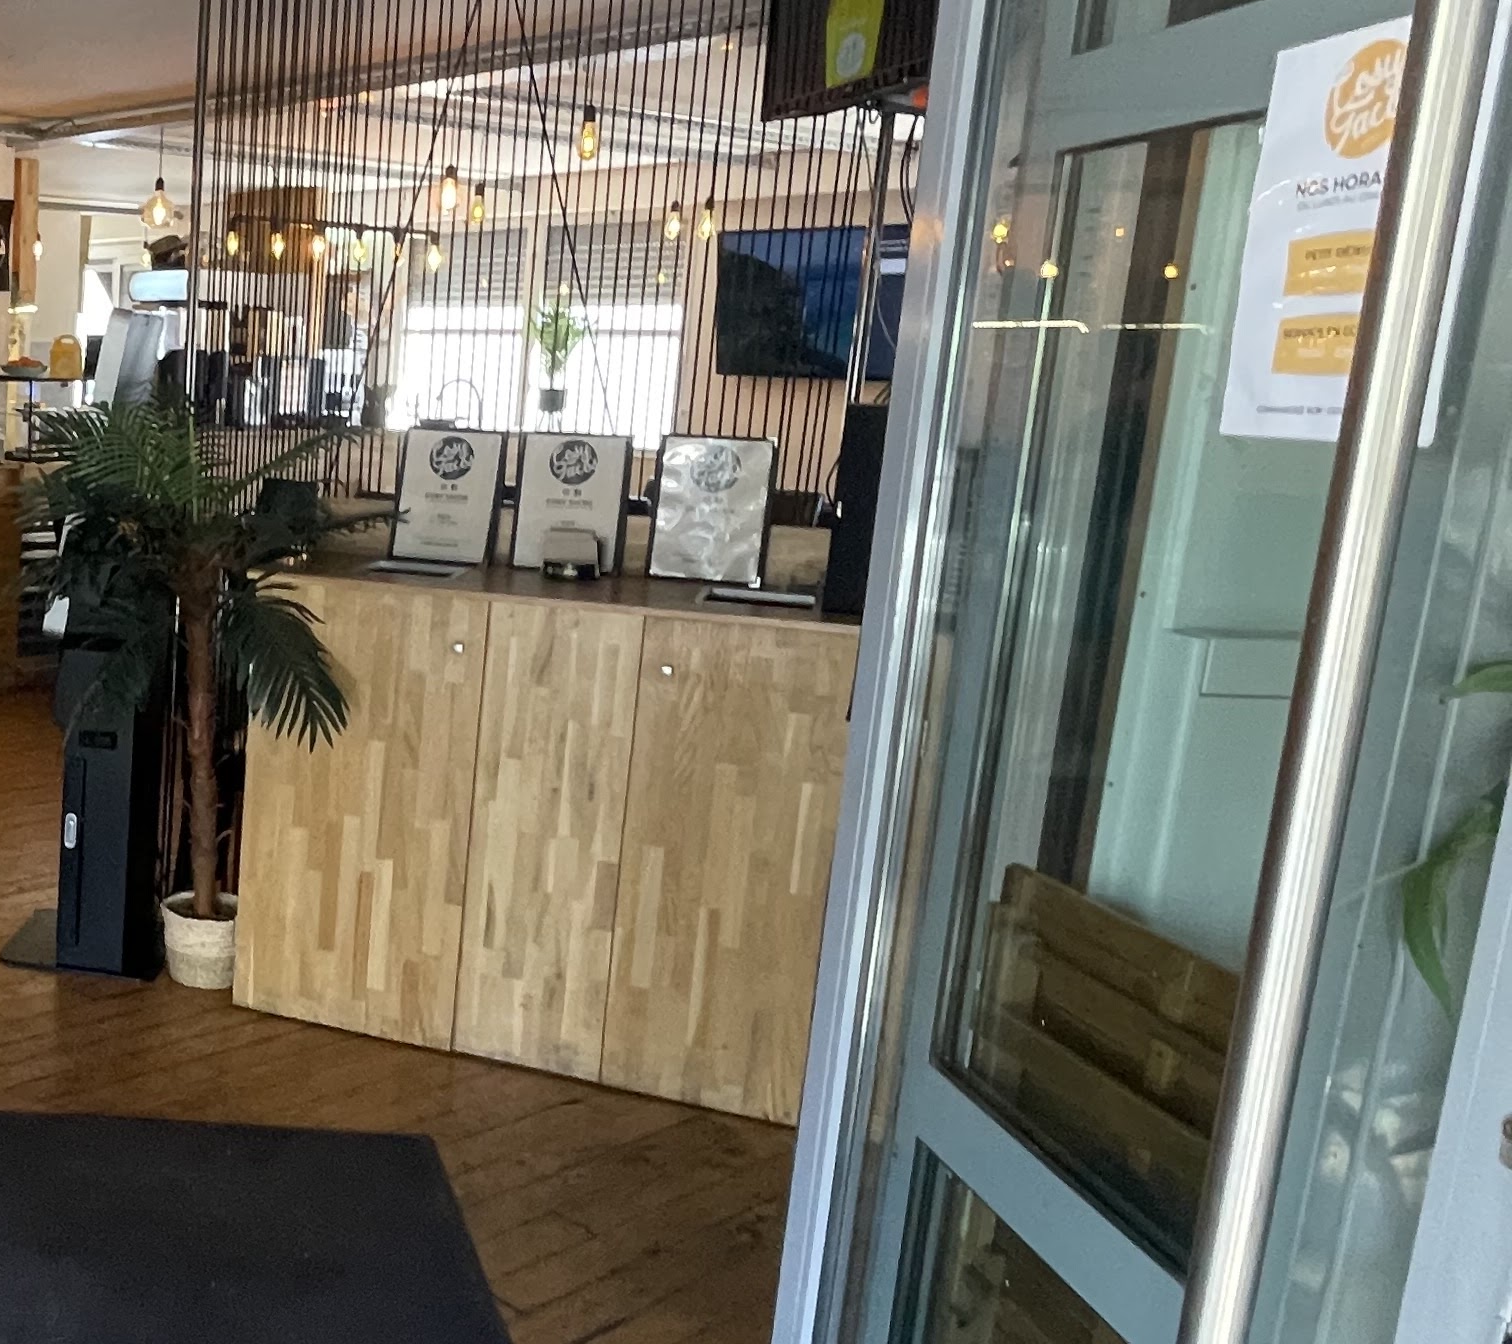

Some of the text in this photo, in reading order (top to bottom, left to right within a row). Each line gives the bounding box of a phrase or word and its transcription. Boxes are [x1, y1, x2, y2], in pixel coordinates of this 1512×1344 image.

[1329, 92, 1399, 154] Taco
[1296, 170, 1381, 198] NOS HORA
